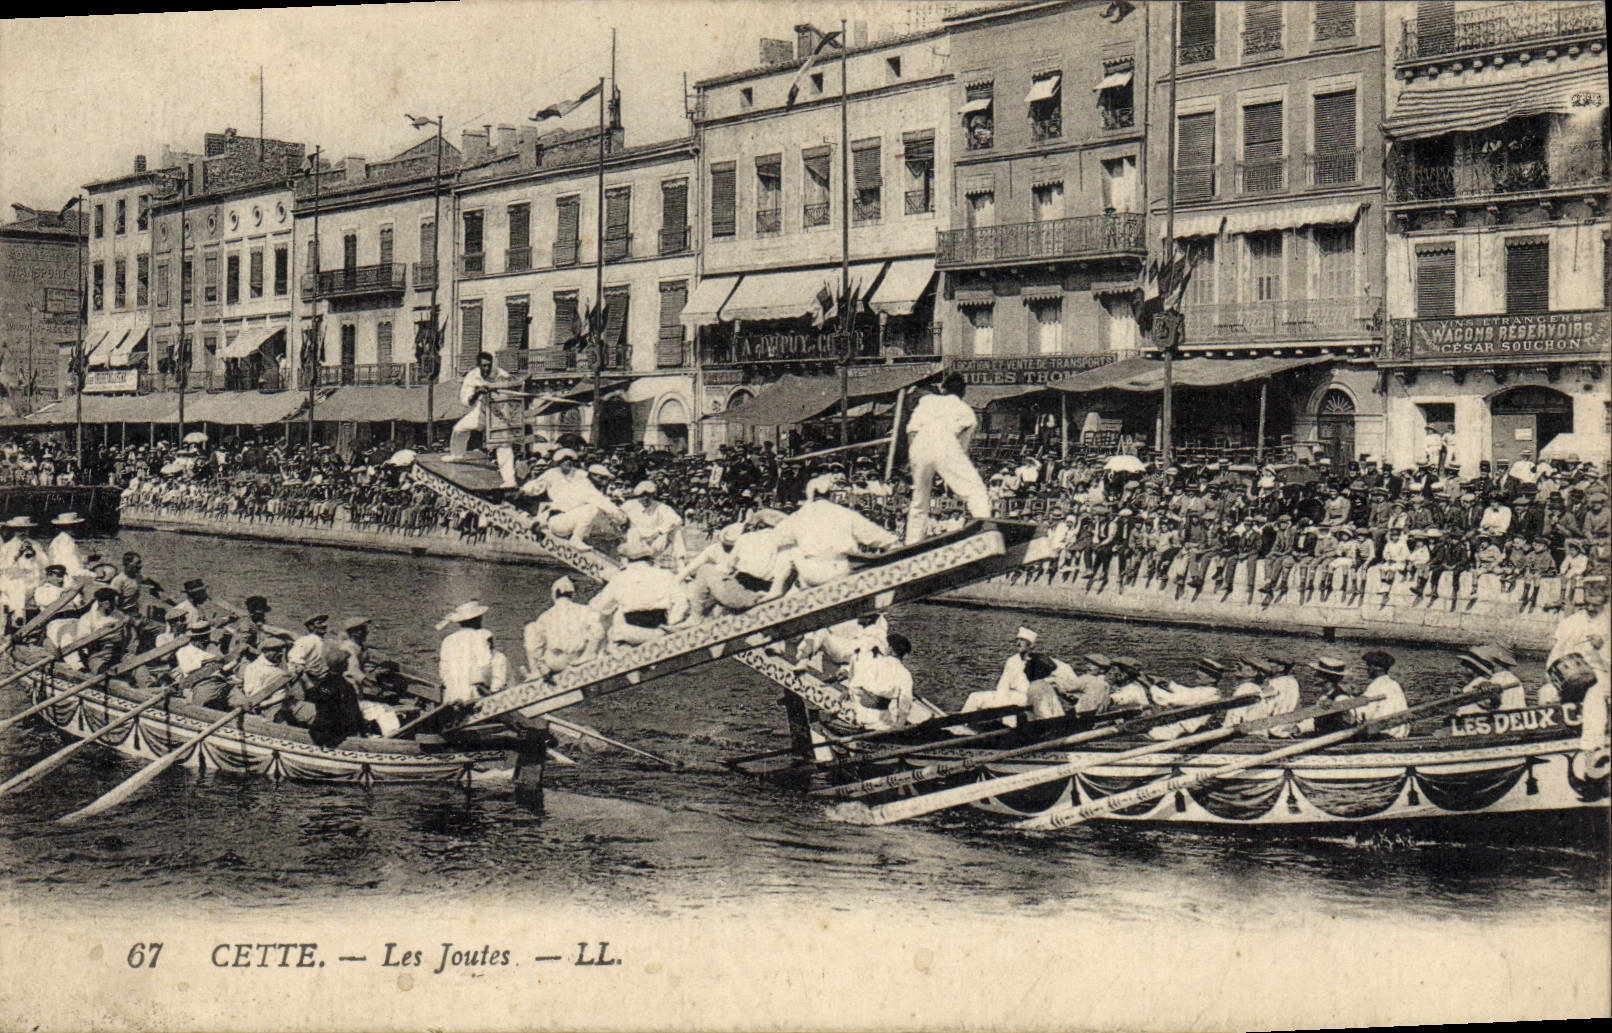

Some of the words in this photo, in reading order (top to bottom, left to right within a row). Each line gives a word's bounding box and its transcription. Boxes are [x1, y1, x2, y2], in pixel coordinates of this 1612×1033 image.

[1440, 319, 1474, 329] VINS
[1432, 326, 1493, 343] WAGONS
[1499, 321, 1593, 342] RÉSERVOIRS
[1441, 343, 1494, 353] CÉSAR
[1501, 338, 1581, 352] SOUCHON
[1006, 359, 1034, 370] VENTE
[1051, 355, 1113, 369] TRANSPORTS
[1452, 716, 1492, 736] LES
[1493, 708, 1559, 734] DEUX
